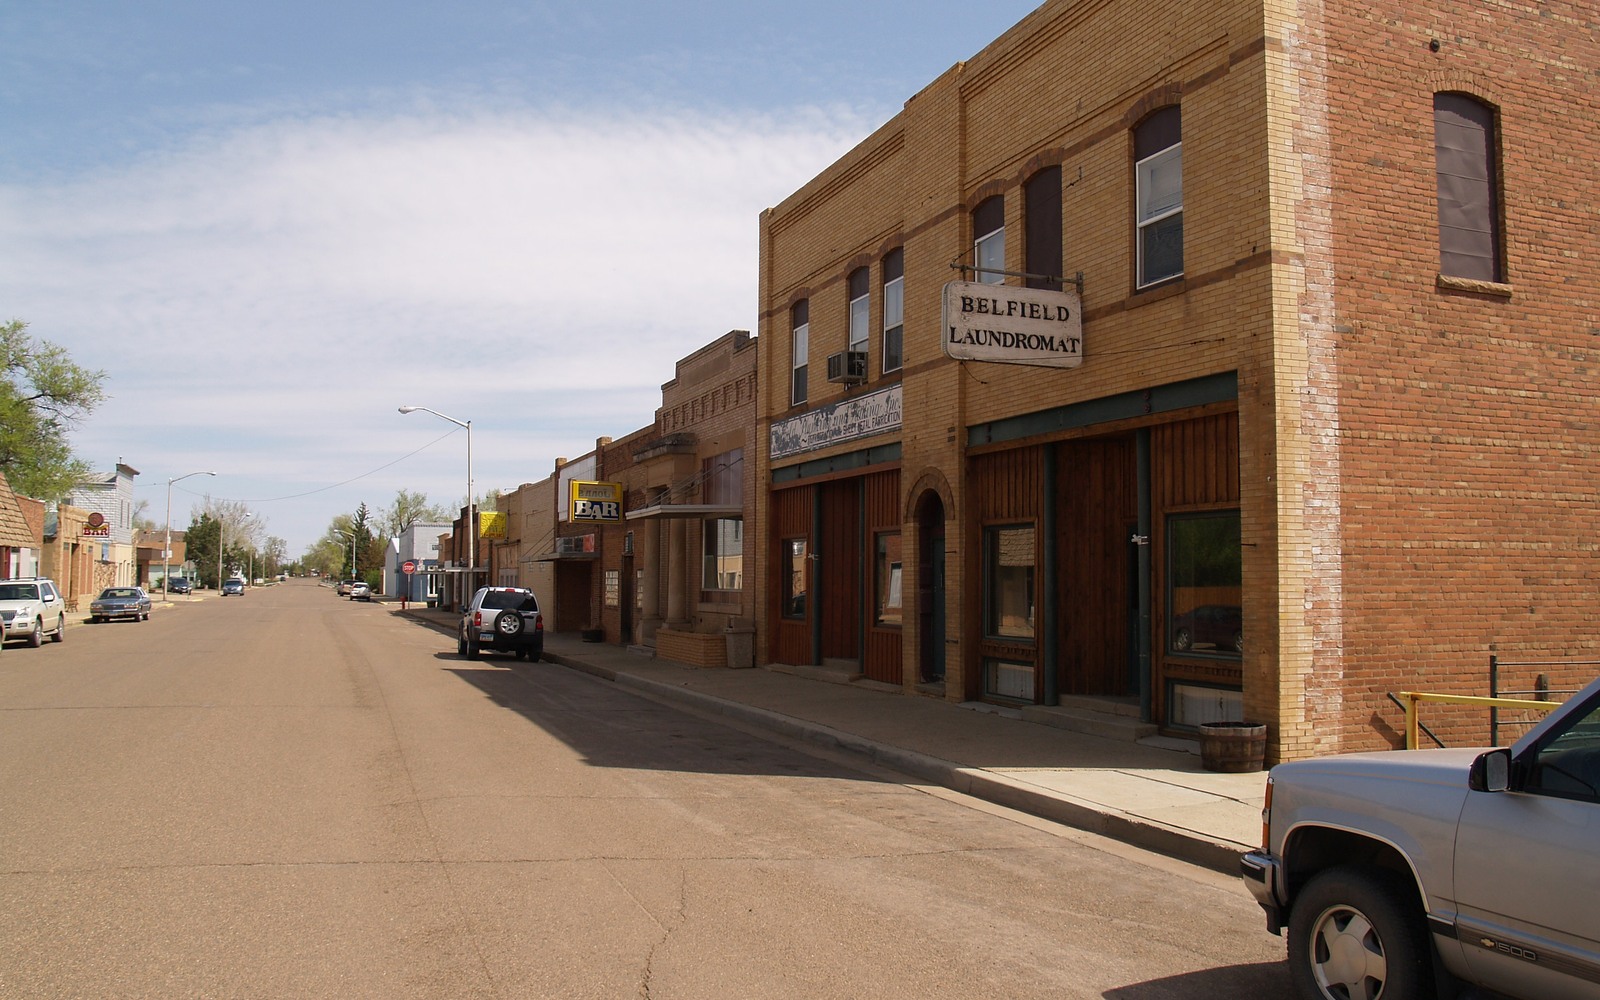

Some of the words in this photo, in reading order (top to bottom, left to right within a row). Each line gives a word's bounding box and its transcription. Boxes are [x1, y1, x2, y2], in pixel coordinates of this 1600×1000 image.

[961, 296, 1070, 322] BELFIELD
[949, 325, 1081, 353] LAUNDROMAT
[575, 501, 619, 520] BAR
[83, 527, 108, 535] BAR
[1496, 941, 1537, 960] 1500
